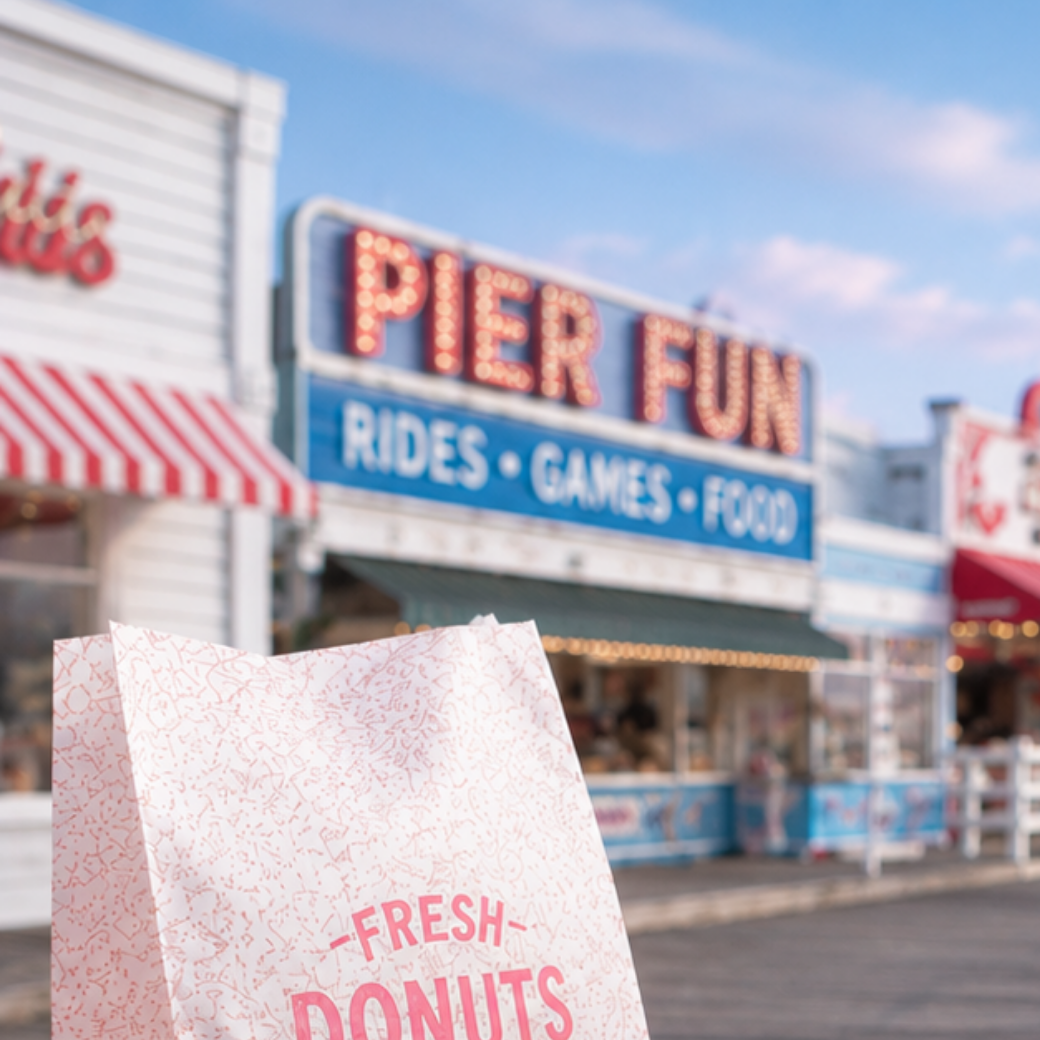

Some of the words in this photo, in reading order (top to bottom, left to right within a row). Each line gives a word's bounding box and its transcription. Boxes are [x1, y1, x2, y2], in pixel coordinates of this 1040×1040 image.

[344, 226, 601, 408] PIER
[635, 311, 802, 457] FUN
[341, 402, 489, 491] RIDES
[531, 444, 672, 525] GAMES
[702, 475, 799, 546] FOOD
[351, 893, 504, 962] FRESH
